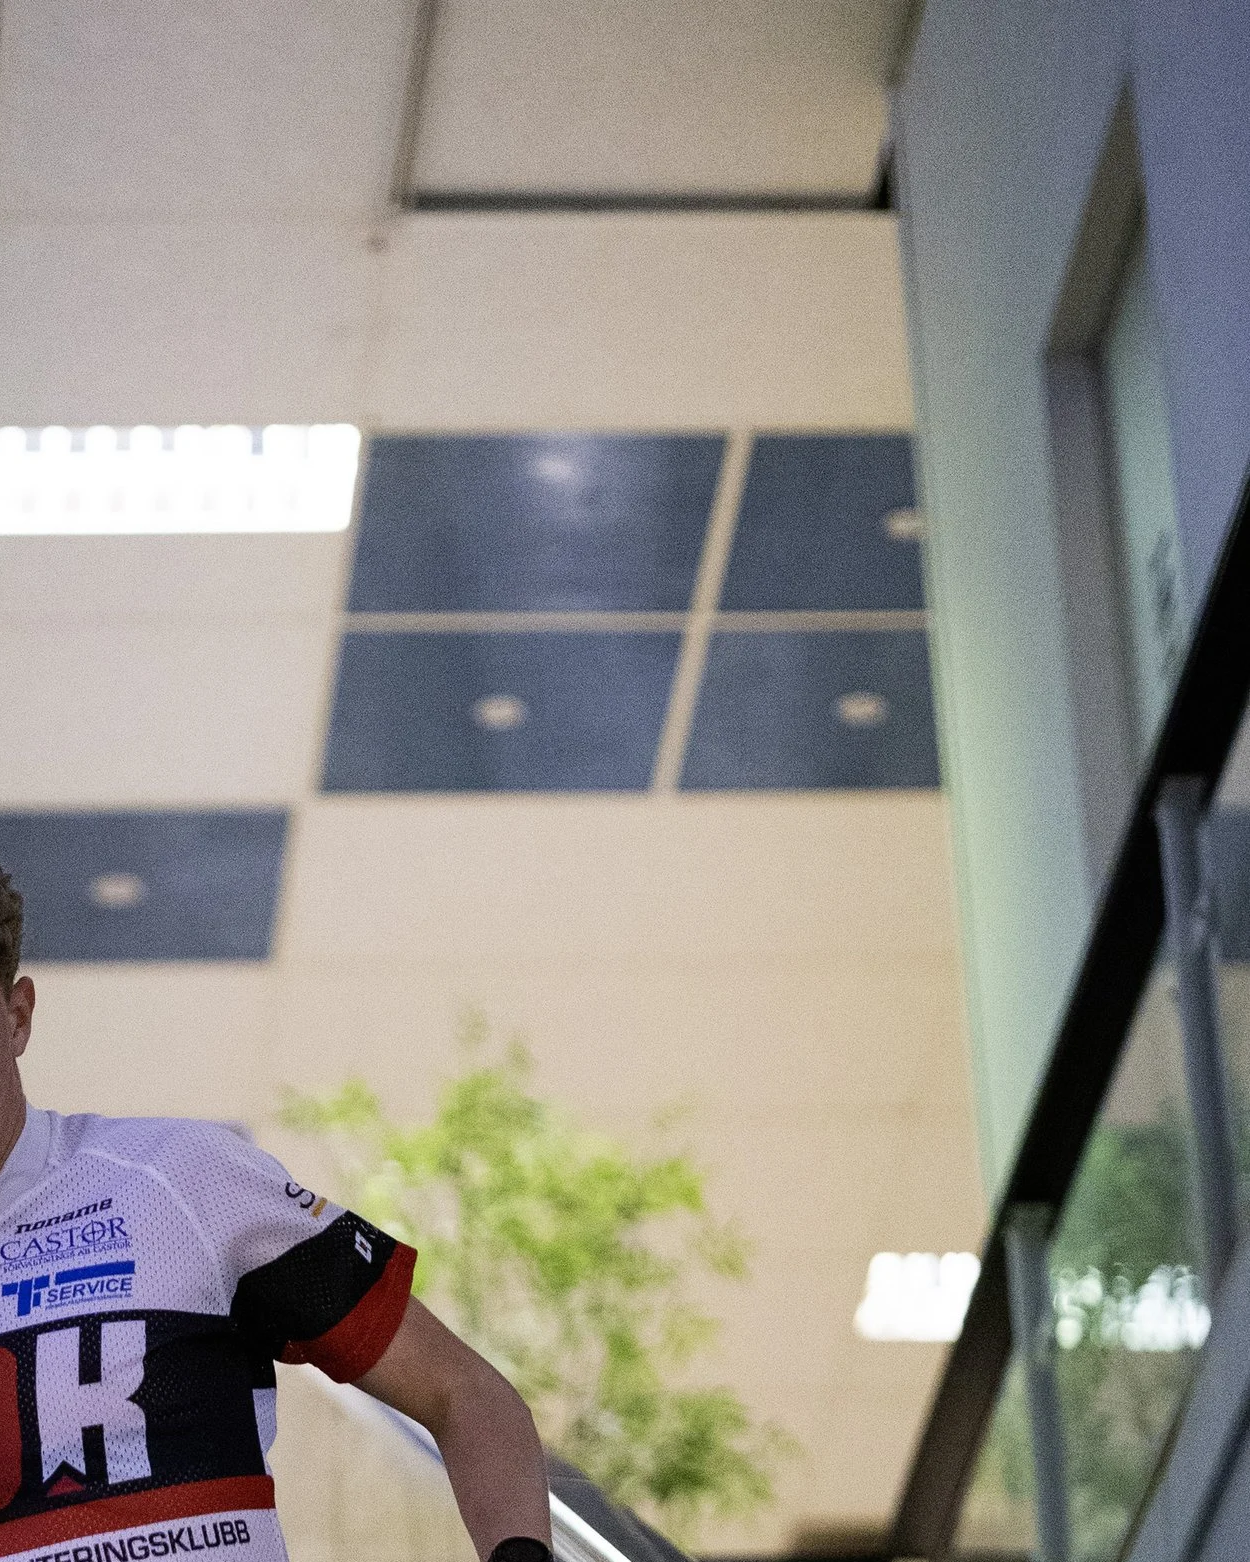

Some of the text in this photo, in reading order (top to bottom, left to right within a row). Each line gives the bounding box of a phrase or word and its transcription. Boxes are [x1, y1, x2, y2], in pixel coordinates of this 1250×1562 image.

[15, 1199, 113, 1235] noname
[0, 1216, 128, 1261] CASTOR
[46, 1277, 133, 1303] SERVICE
